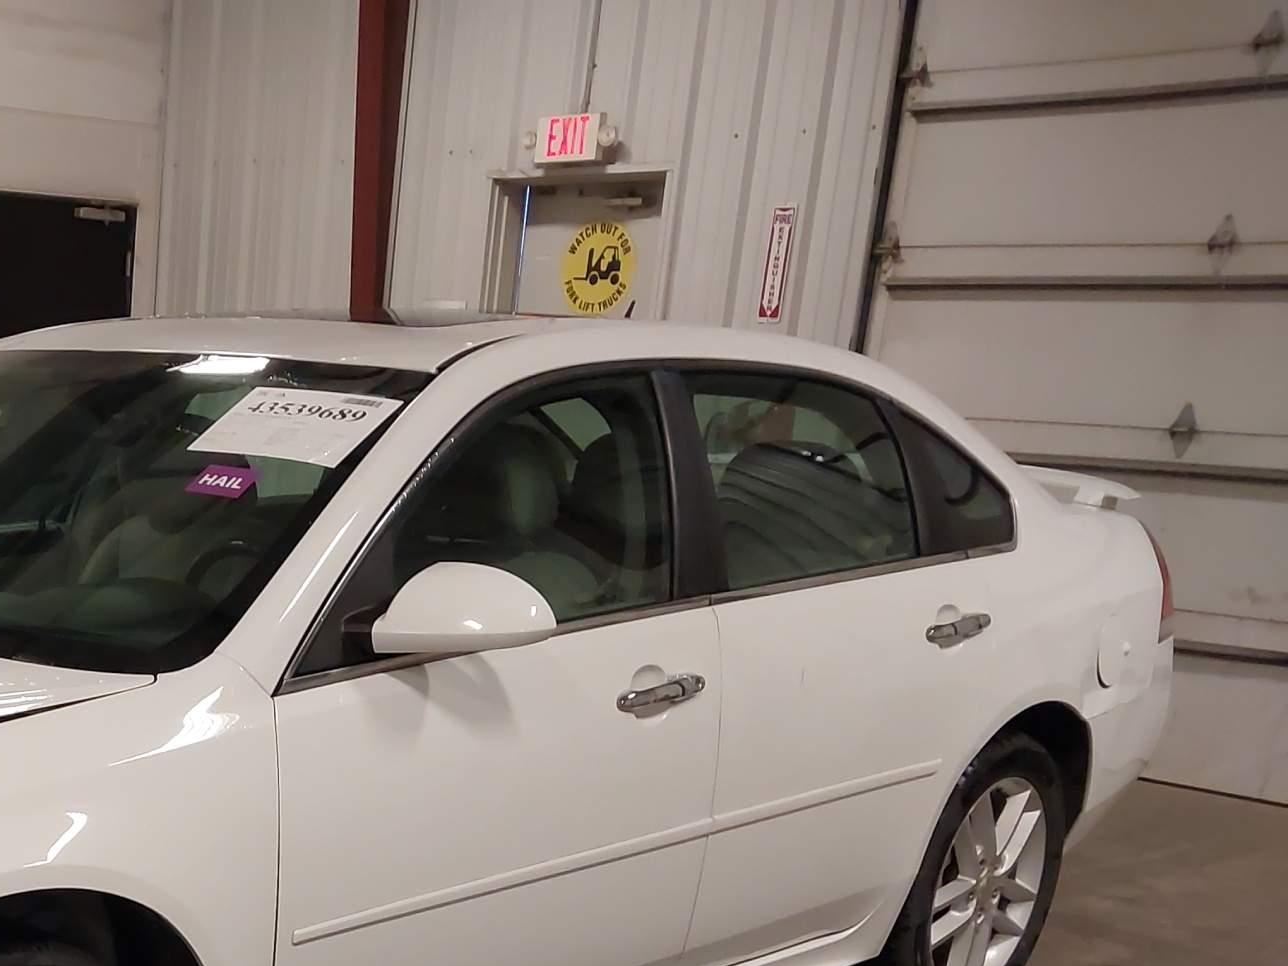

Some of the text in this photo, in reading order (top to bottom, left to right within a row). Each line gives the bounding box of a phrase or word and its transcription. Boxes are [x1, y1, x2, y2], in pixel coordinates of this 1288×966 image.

[546, 114, 590, 157] EXIT
[773, 213, 792, 225] FIRE
[568, 223, 632, 255] WATCH OUT FOR
[564, 279, 627, 313] FORK LIFT TRUCKS
[247, 400, 368, 423] 43539689
[198, 473, 243, 490] HAIL
